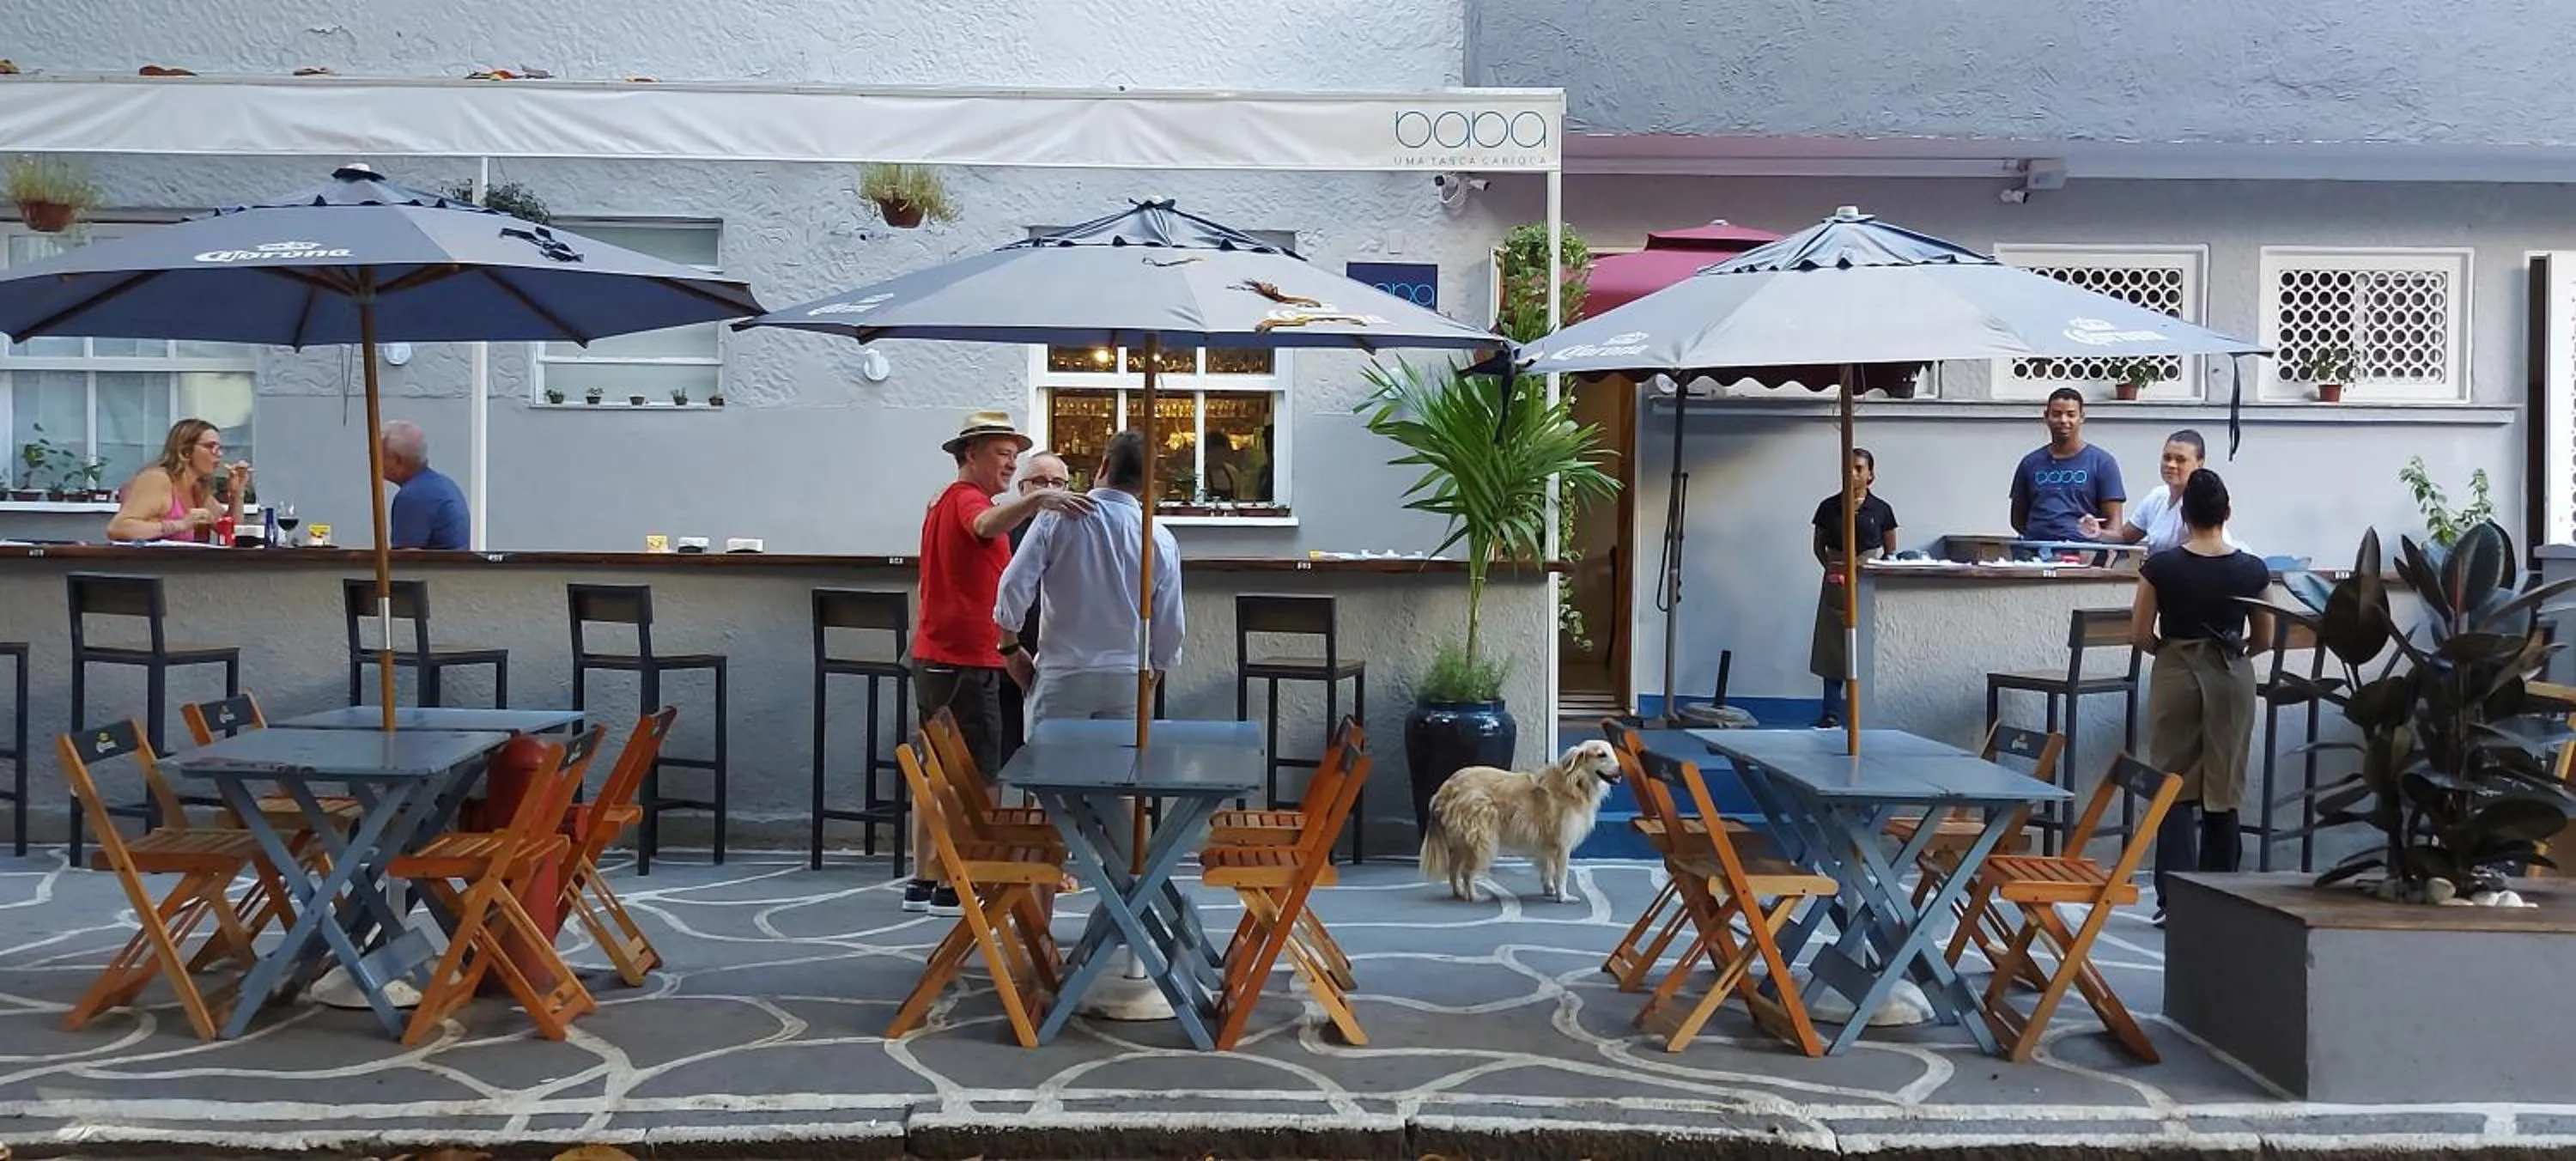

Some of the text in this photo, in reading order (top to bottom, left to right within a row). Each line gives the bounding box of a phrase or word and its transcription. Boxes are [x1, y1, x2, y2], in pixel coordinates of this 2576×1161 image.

[1395, 111, 1546, 149] baba
[1394, 156, 1546, 166] UMA TASCA CARIOCA
[194, 248, 357, 263] Corona
